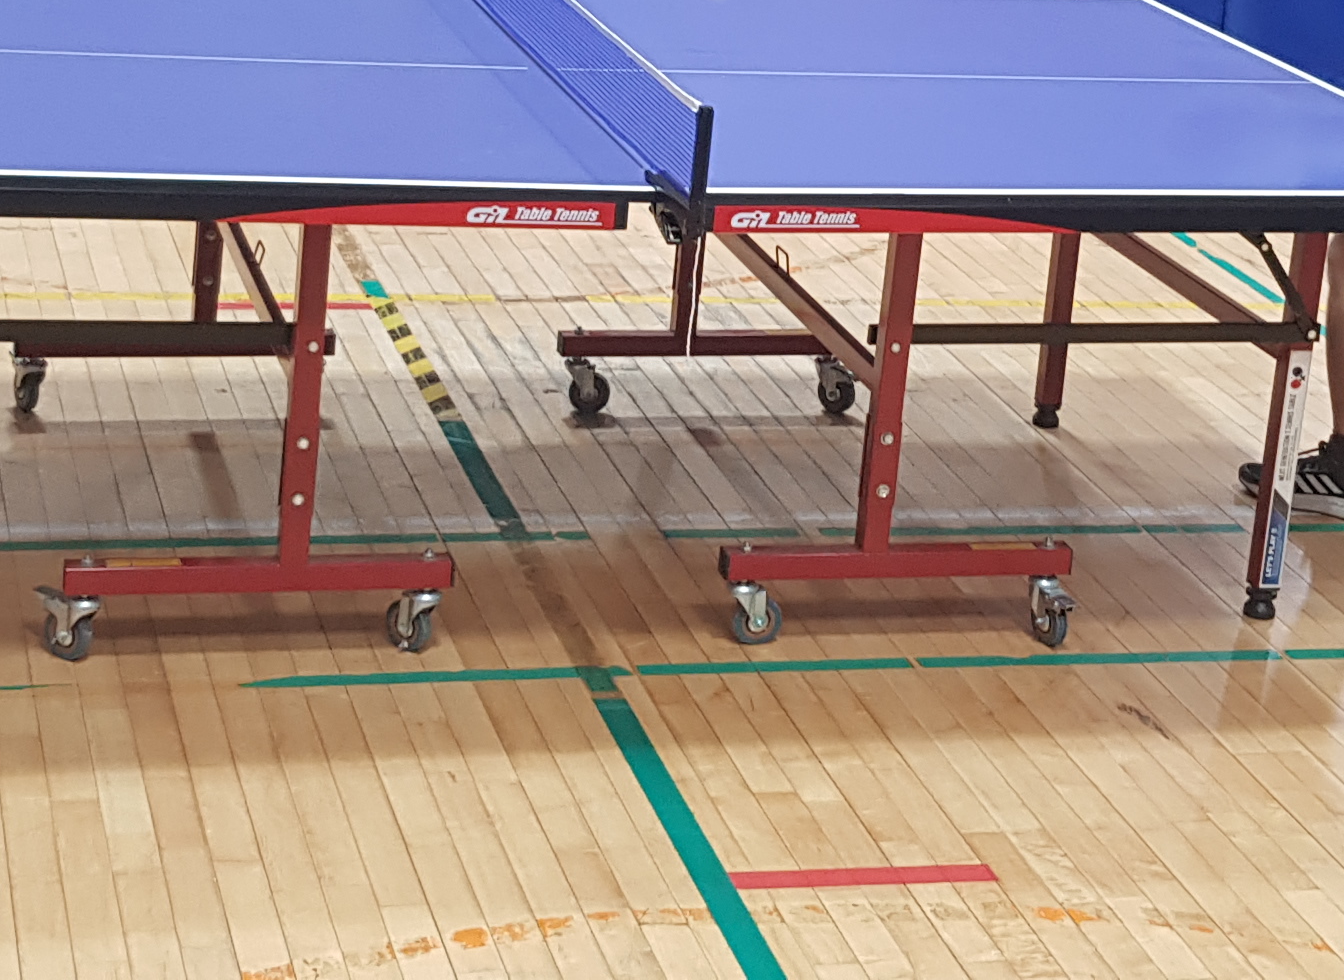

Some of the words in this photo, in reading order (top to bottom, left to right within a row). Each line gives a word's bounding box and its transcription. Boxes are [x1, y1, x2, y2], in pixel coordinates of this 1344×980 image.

[514, 206, 553, 221] Table
[554, 207, 600, 222] Tennis
[776, 210, 812, 224] Table
[813, 210, 857, 224] Tennis
